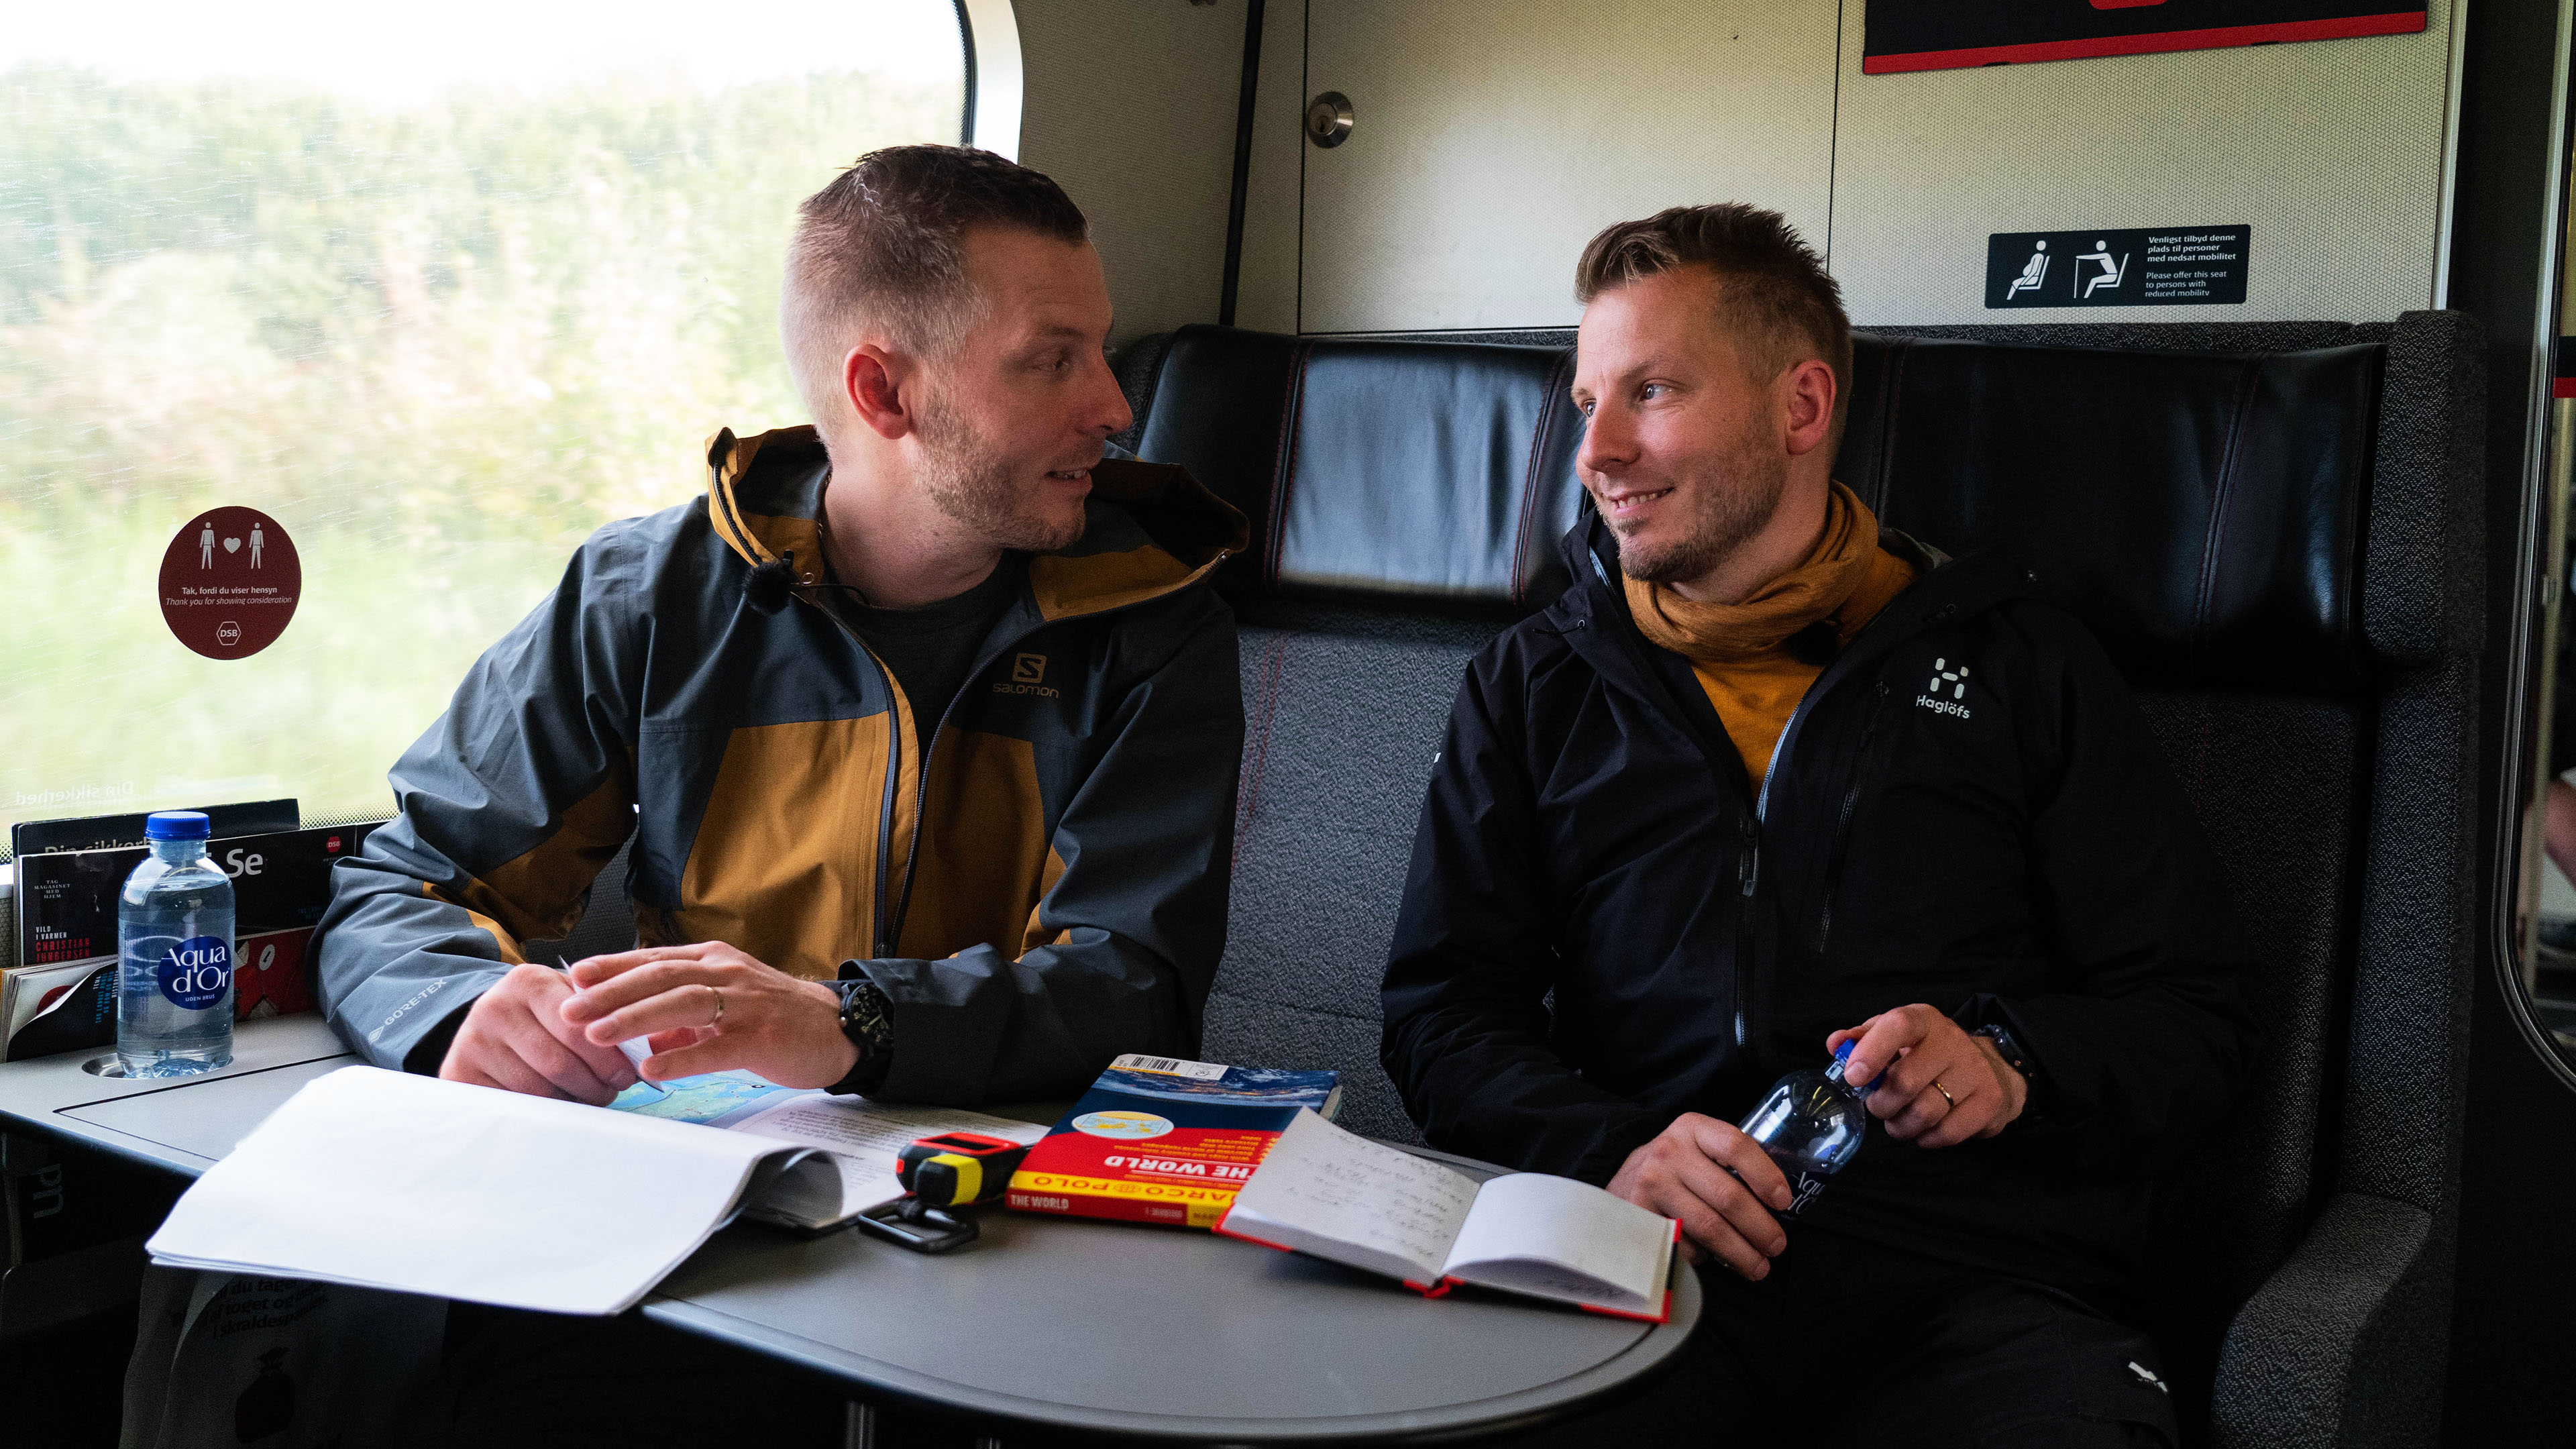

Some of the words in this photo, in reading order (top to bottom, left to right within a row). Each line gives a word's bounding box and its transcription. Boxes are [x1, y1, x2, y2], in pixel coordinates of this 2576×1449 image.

[2184, 235, 2208, 243] tilbyd
[2148, 246, 2170, 254] plads
[2183, 245, 2220, 253] personer
[2156, 280, 2186, 289] persons
[182, 587, 197, 595] Tak,
[251, 586, 278, 595] hensyn
[166, 598, 188, 606] Thank
[189, 598, 202, 606] you
[205, 597, 215, 605] for
[216, 597, 246, 606] showing
[247, 596, 292, 604] consideration
[220, 629, 237, 637] DSB
[1916, 695, 1970, 718] Haglöfs
[227, 848, 264, 878] Se
[42, 932, 67, 940] VARMEN
[36, 937, 90, 952] CHRISTIAN
[162, 946, 226, 973] Aqua
[384, 979, 447, 1026] GORE-TEX
[1104, 1156, 1205, 1175] WORLD
[1213, 1165, 1256, 1179] HE
[1034, 1176, 1109, 1191] POLO
[1792, 1172, 1825, 1199] Aqu
[1146, 1185, 1238, 1202] ARCO
[1010, 1194, 1029, 1206] THE
[1031, 1195, 1069, 1210] WORLD
